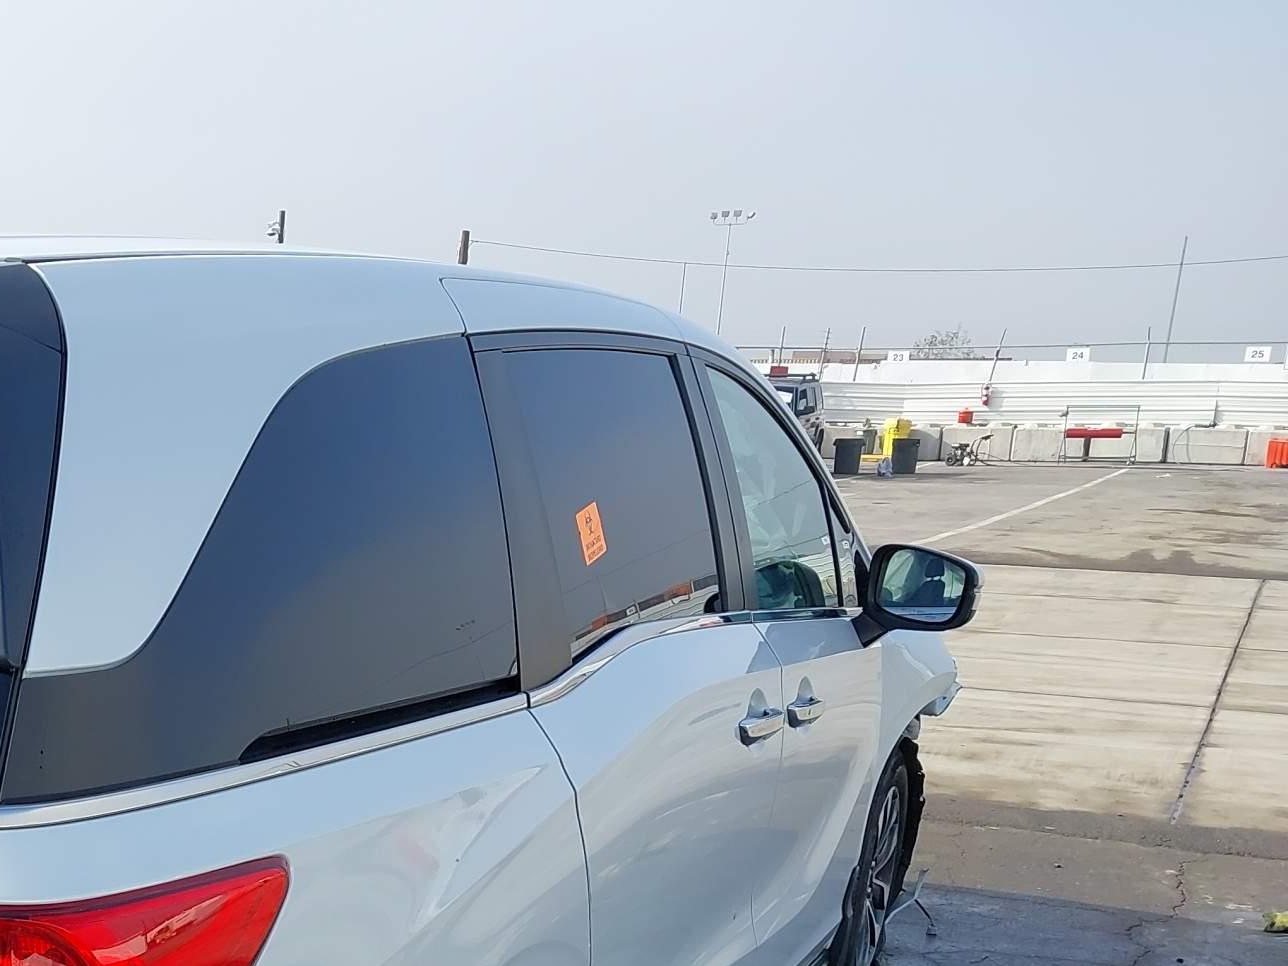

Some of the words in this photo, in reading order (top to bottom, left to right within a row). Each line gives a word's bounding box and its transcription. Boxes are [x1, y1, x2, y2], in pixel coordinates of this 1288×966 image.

[893, 353, 904, 362] 23
[1071, 351, 1084, 360] 24
[1251, 350, 1265, 359] 25
